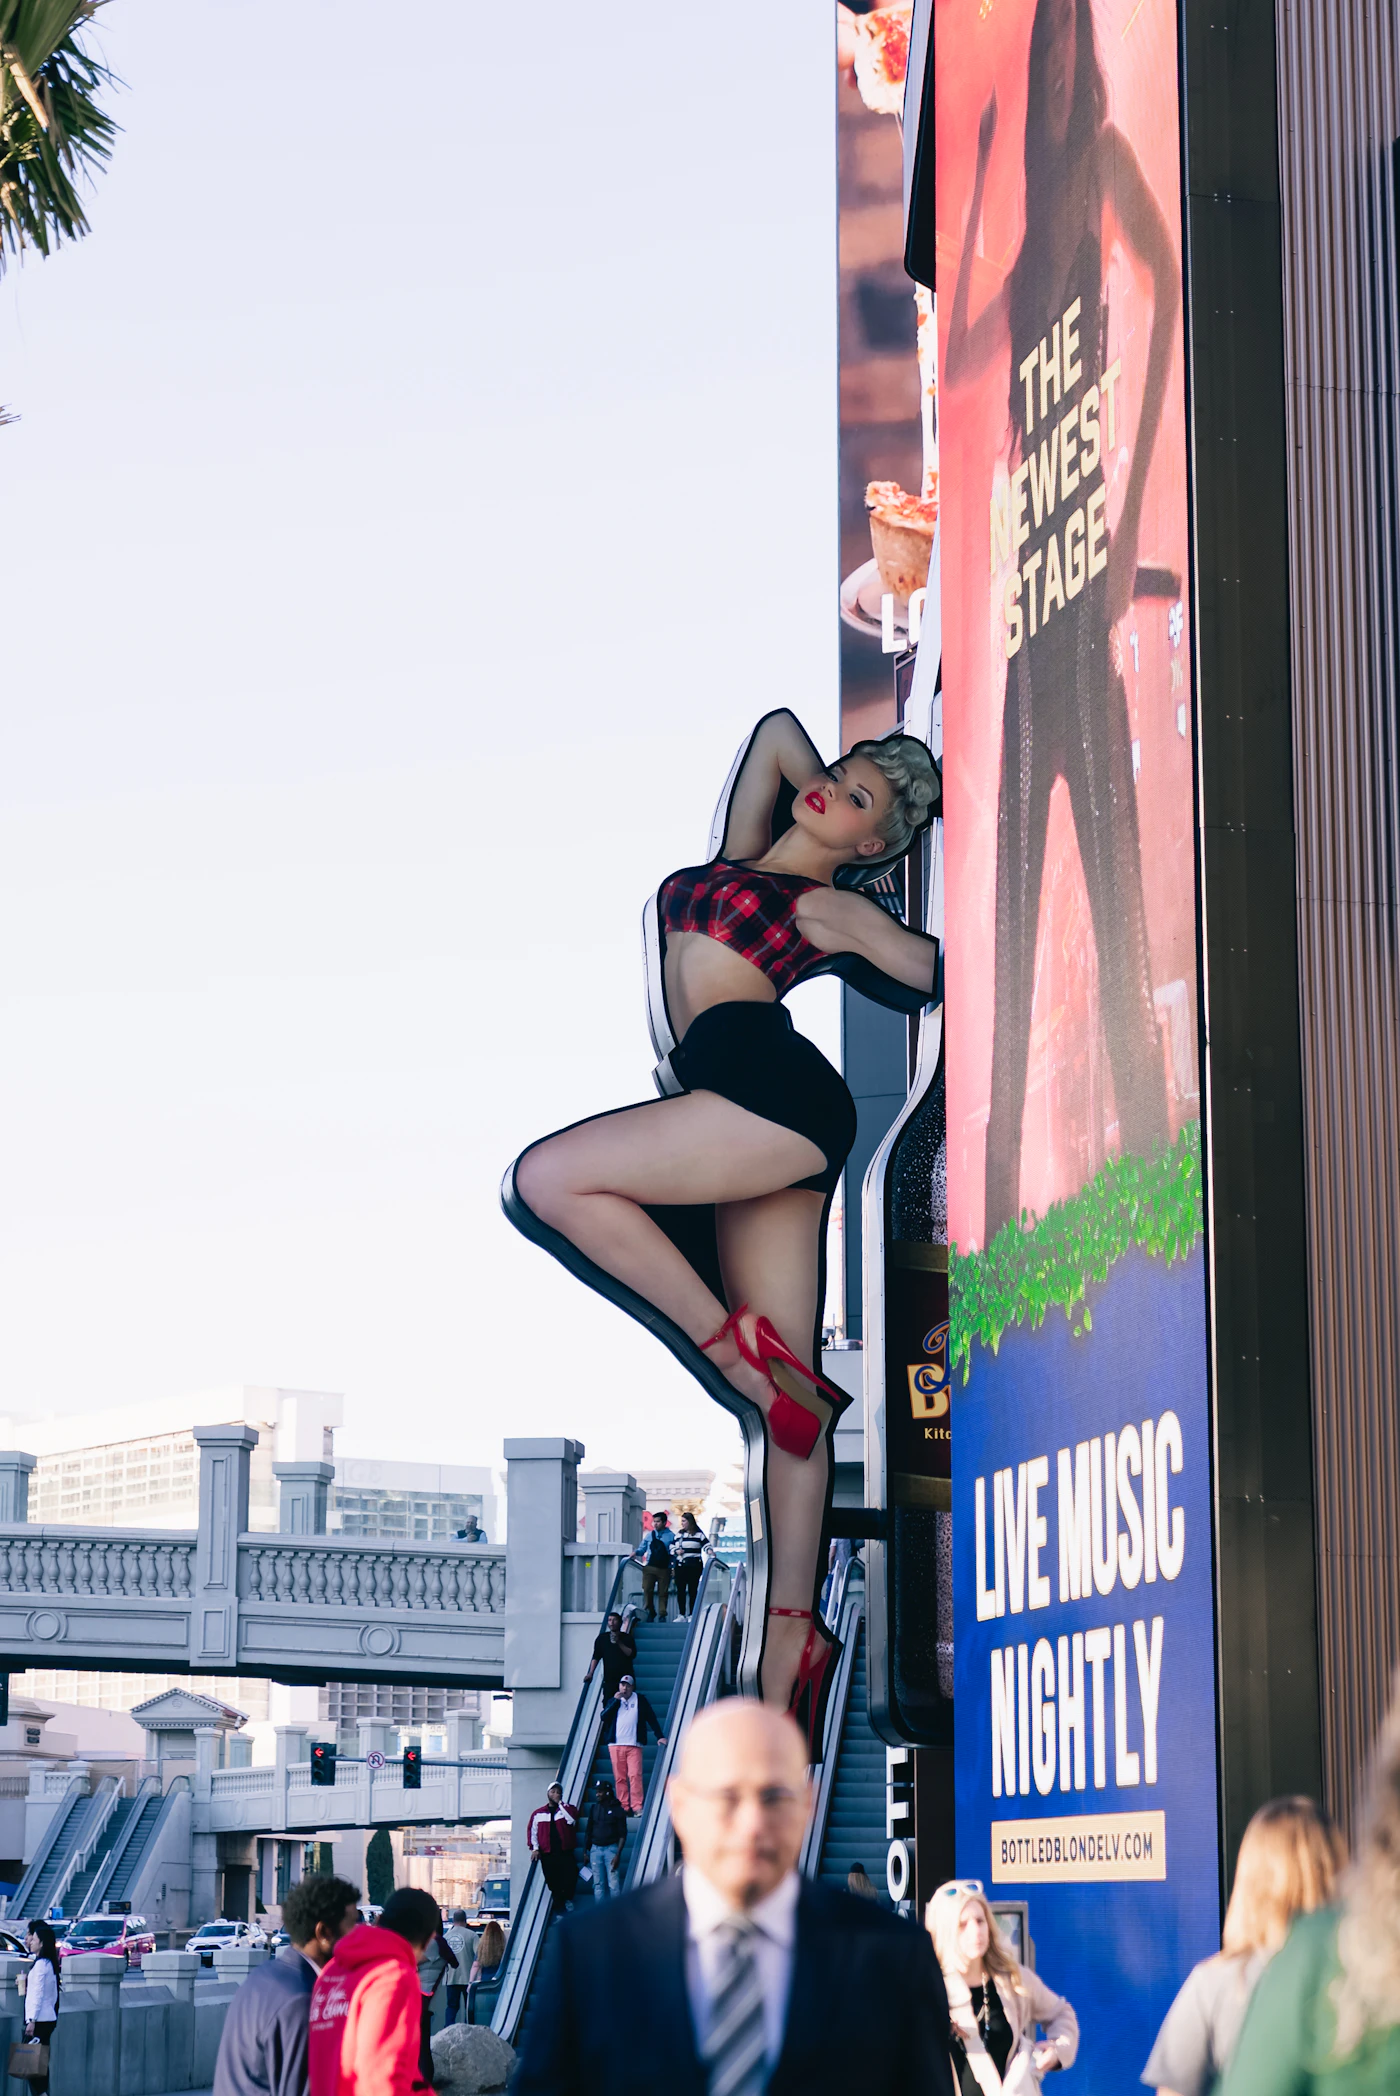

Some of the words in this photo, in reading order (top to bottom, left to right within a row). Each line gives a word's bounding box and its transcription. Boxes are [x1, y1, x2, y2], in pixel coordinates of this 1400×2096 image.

[1019, 296, 1082, 436] THE
[990, 357, 1121, 575] NEWEST
[1004, 482, 1107, 659] STAGE
[975, 1455, 1050, 1622] LIVE
[1057, 1409, 1185, 1603] MUSIC
[991, 1616, 1164, 1797] NIGHTLY
[1001, 1831, 1153, 1864] BOTTLEDBLONDELV.COM
